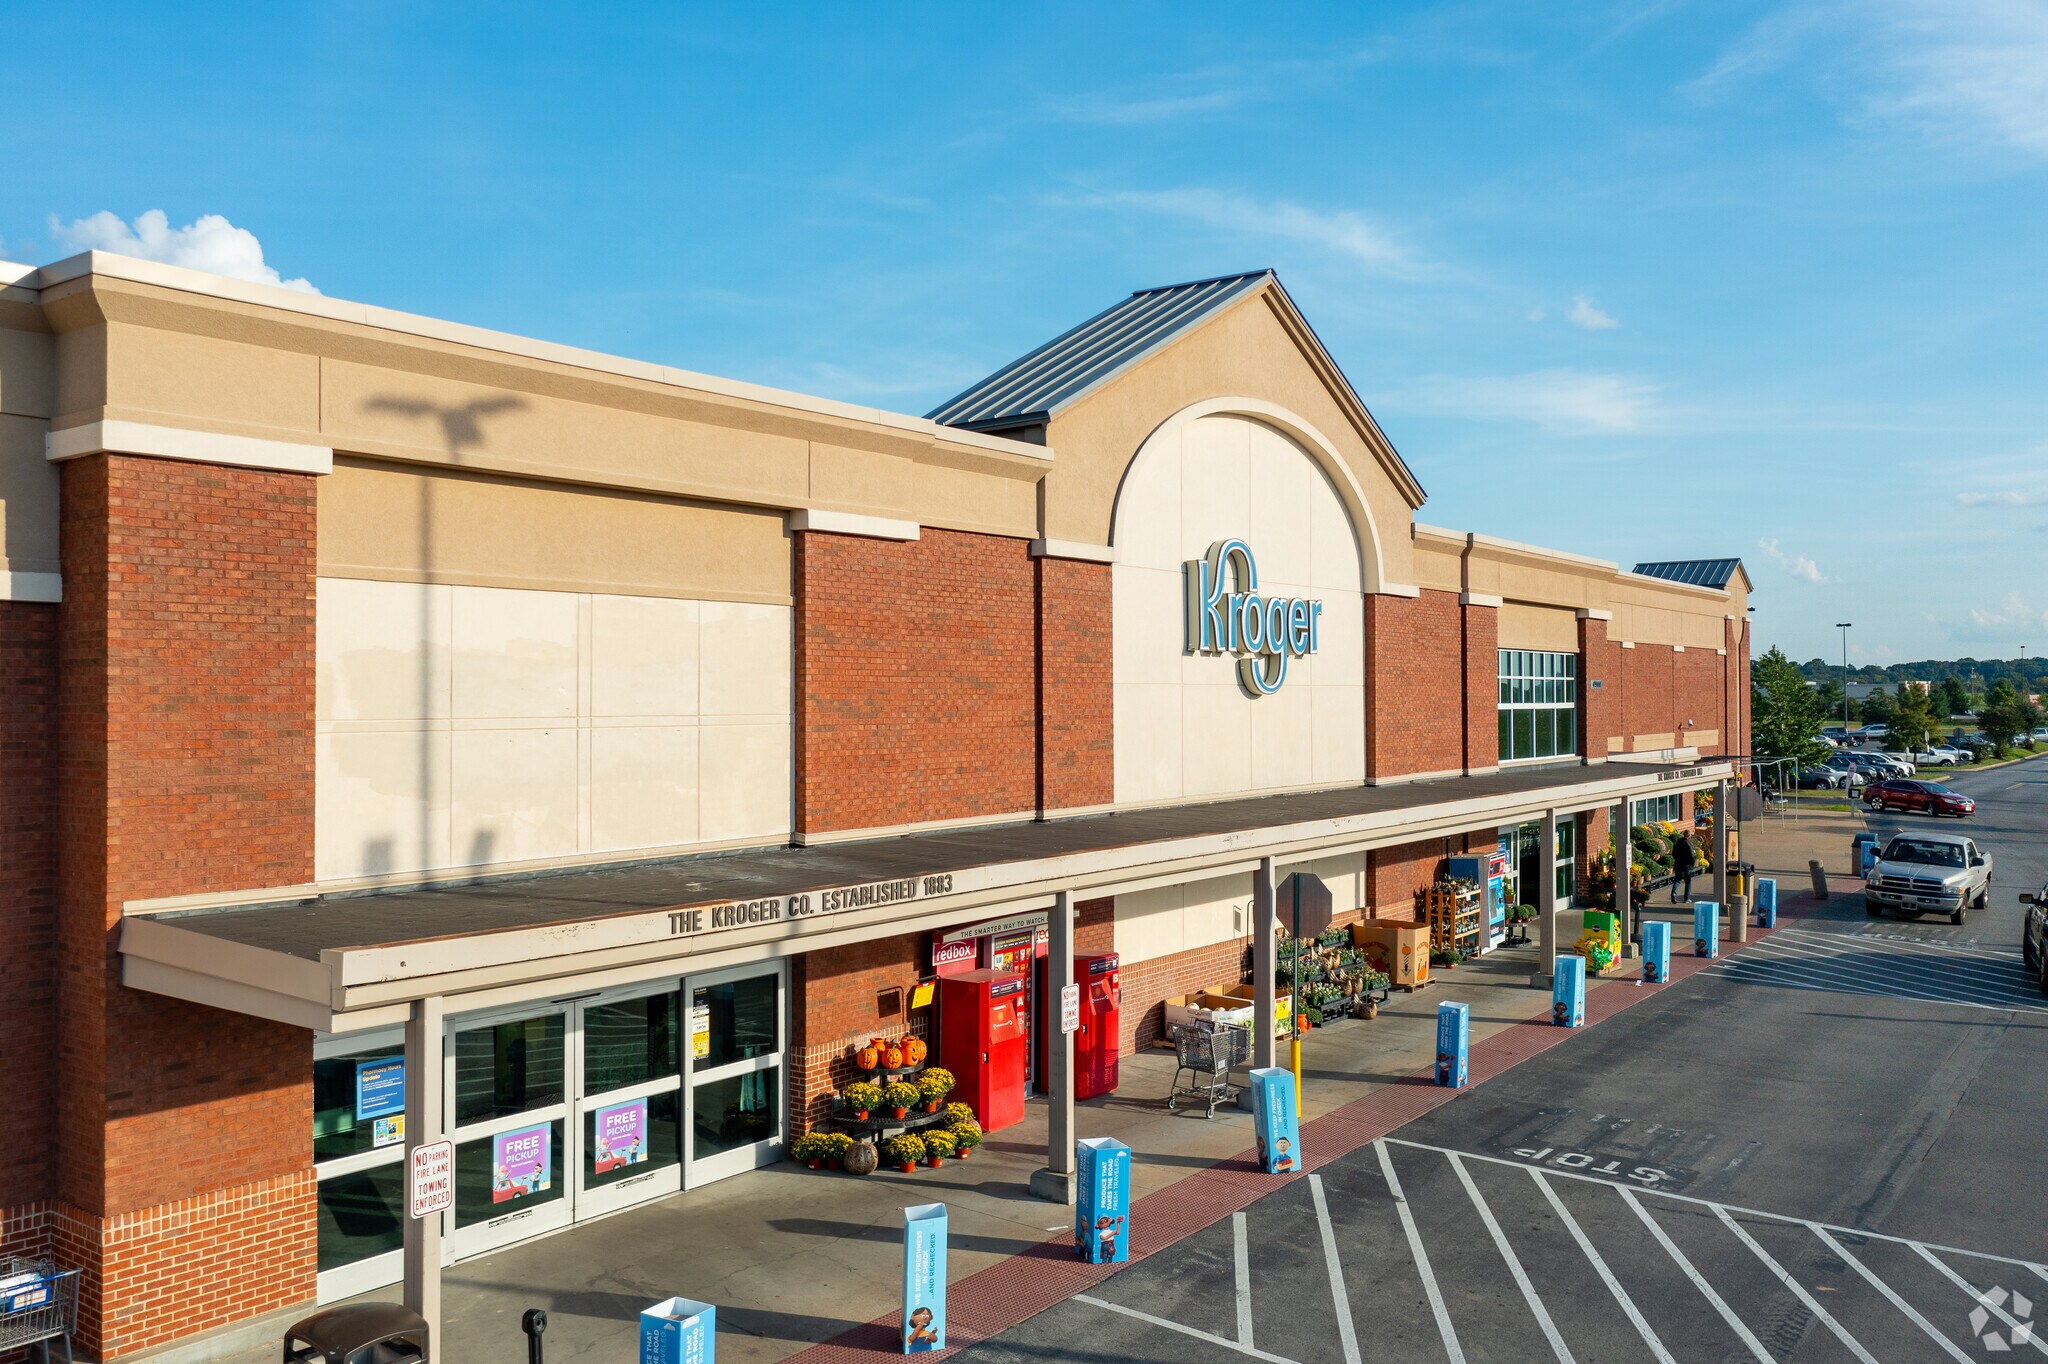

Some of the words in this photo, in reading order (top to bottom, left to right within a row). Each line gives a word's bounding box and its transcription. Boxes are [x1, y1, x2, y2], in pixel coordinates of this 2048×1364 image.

[1195, 538, 1322, 695] Kroger
[668, 910, 702, 934] THE
[712, 898, 780, 928] KROGER
[788, 894, 814, 916] CO.
[822, 879, 917, 911] ESTABLISHED
[923, 874, 953, 896] 1883
[974, 925, 1002, 936] SMARTER
[1026, 916, 1045, 925] WATCH
[936, 944, 971, 962] redbox
[1113, 973, 1118, 983] B
[1017, 997, 1024, 1007] A
[606, 1110, 636, 1127] FREE
[606, 1122, 636, 1137] PICKUP
[1273, 1129, 1278, 1138] WE
[506, 1136, 539, 1154] FREE
[416, 1152, 427, 1167] NO
[429, 1150, 448, 1162] PARKING
[506, 1149, 539, 1165] PICKUP
[417, 1168, 430, 1179] FIRE
[433, 1163, 448, 1174] LANE
[419, 1178, 447, 1195] TOWING
[416, 1191, 450, 1210] ENFORCED
[915, 1293, 920, 1305] WE
